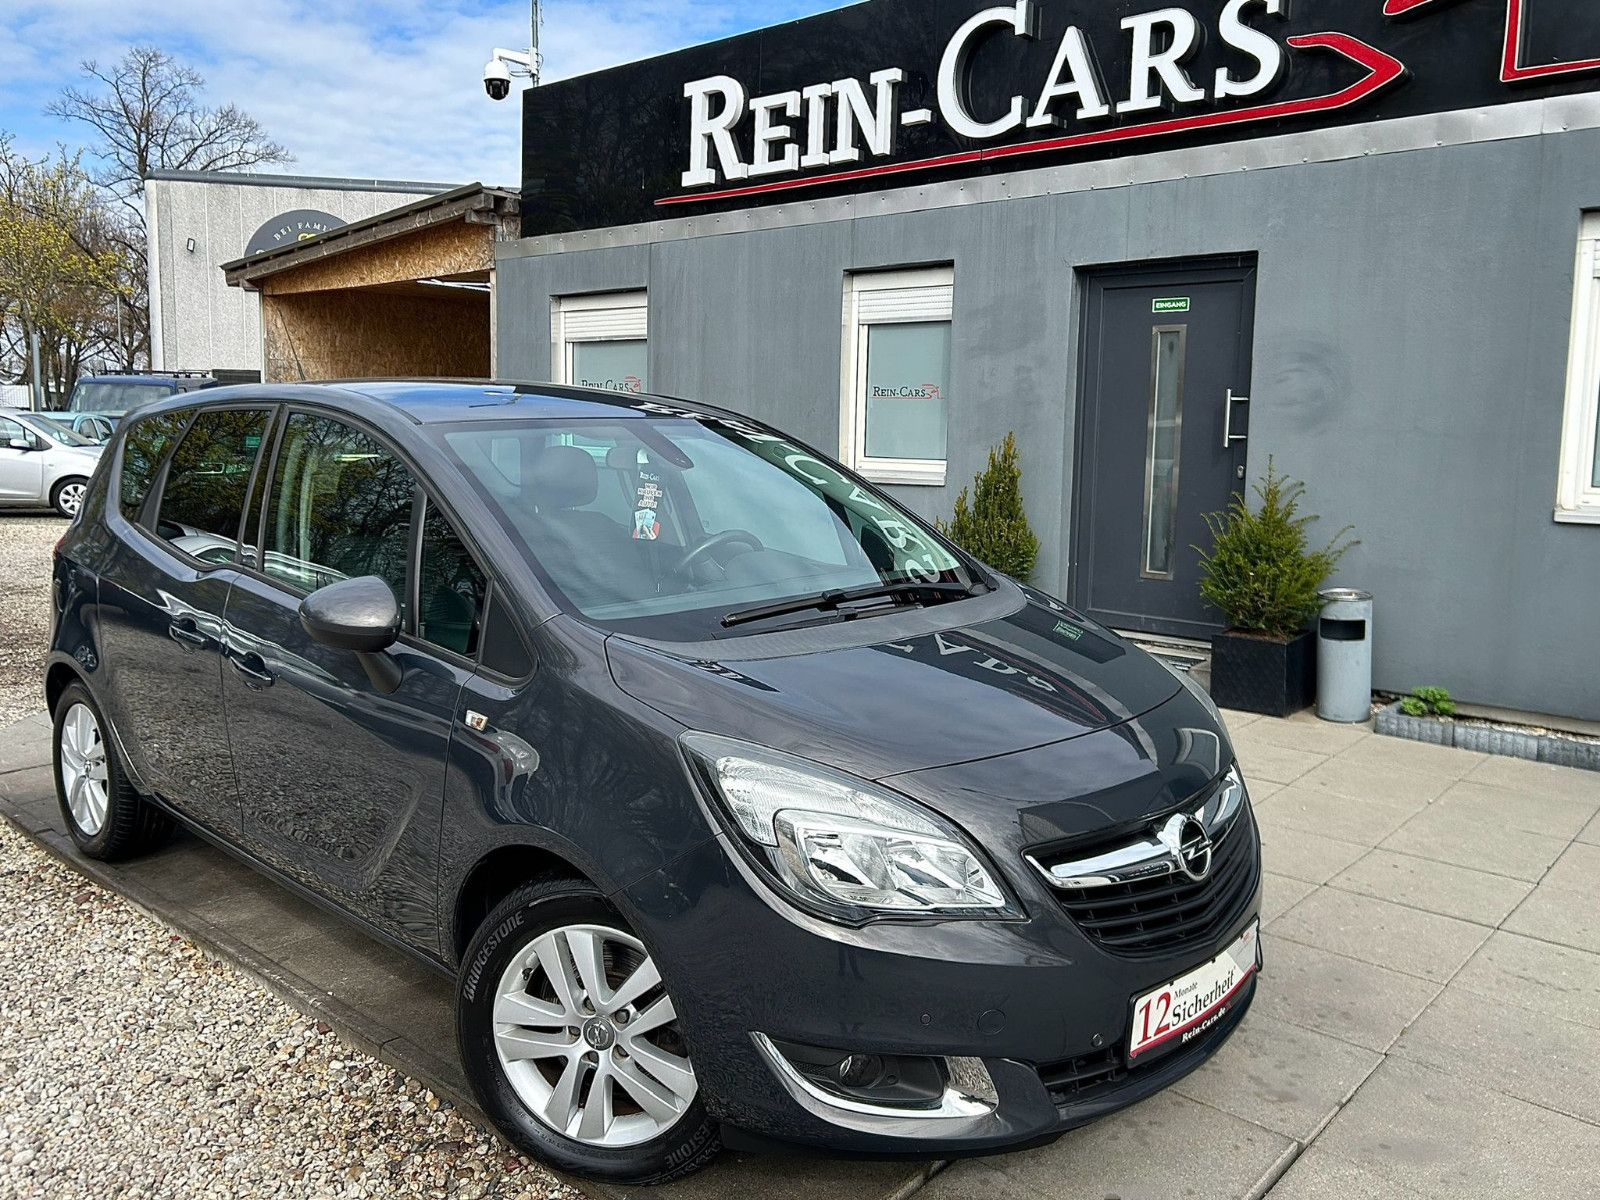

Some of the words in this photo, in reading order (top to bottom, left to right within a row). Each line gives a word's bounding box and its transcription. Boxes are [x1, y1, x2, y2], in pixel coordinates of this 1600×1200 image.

[681, 0, 1288, 187] REIN-CARS
[273, 226, 292, 241] BEI
[297, 222, 333, 232] FAMI
[1155, 301, 1187, 309] EINGANG
[873, 386, 926, 397] REIN-CARS
[463, 910, 525, 1003] BRIDGESTONE
[1174, 982, 1198, 999] Monate
[1137, 991, 1171, 1046] 12
[1171, 970, 1234, 1027] Sicherheit
